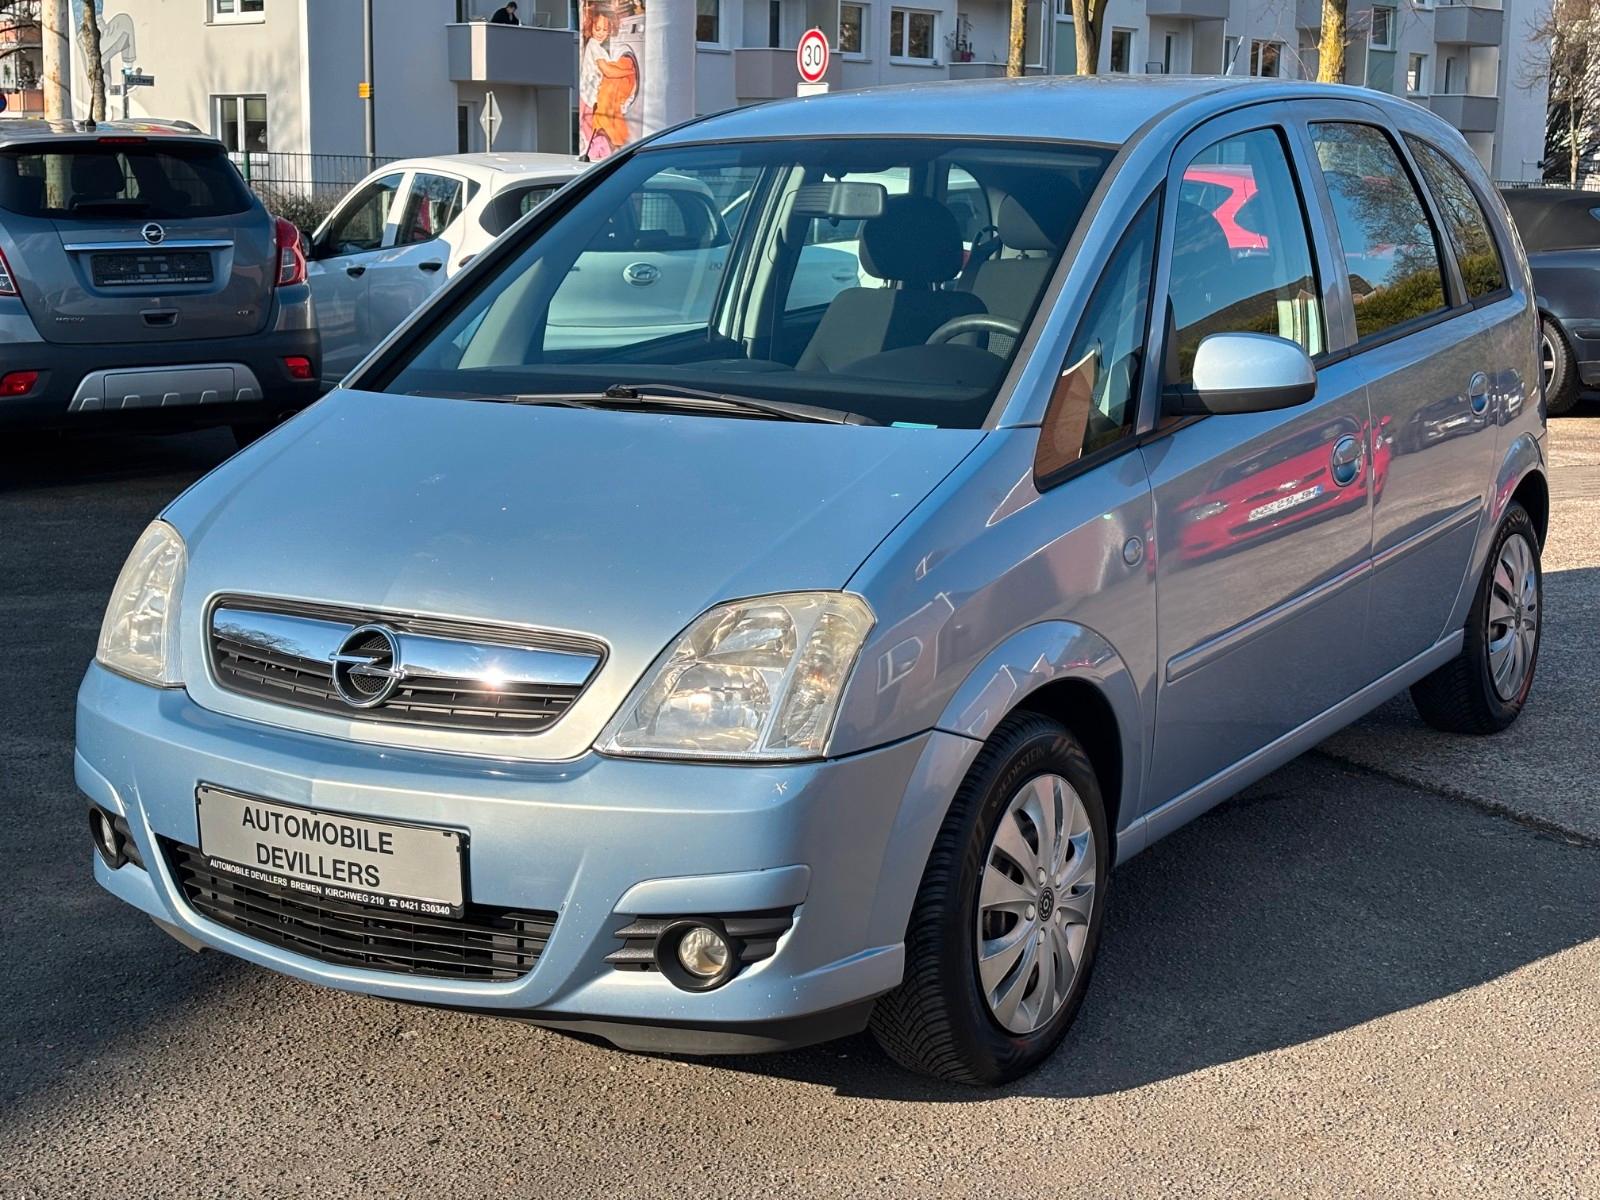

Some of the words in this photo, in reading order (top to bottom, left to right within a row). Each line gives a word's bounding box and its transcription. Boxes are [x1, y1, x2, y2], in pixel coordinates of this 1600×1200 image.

[804, 44, 822, 67] 30
[242, 806, 394, 855] AUTOMOBILE
[209, 859, 250, 877] AUTOMOBILE
[250, 870, 288, 887] DEVILLERS
[290, 880, 322, 894] BREMEN
[325, 887, 369, 903] KIRCHWEG
[370, 895, 385, 906] 210
[400, 900, 419, 911] 0421
[420, 902, 450, 915] 530340
[256, 842, 380, 888] DEVILLERS
